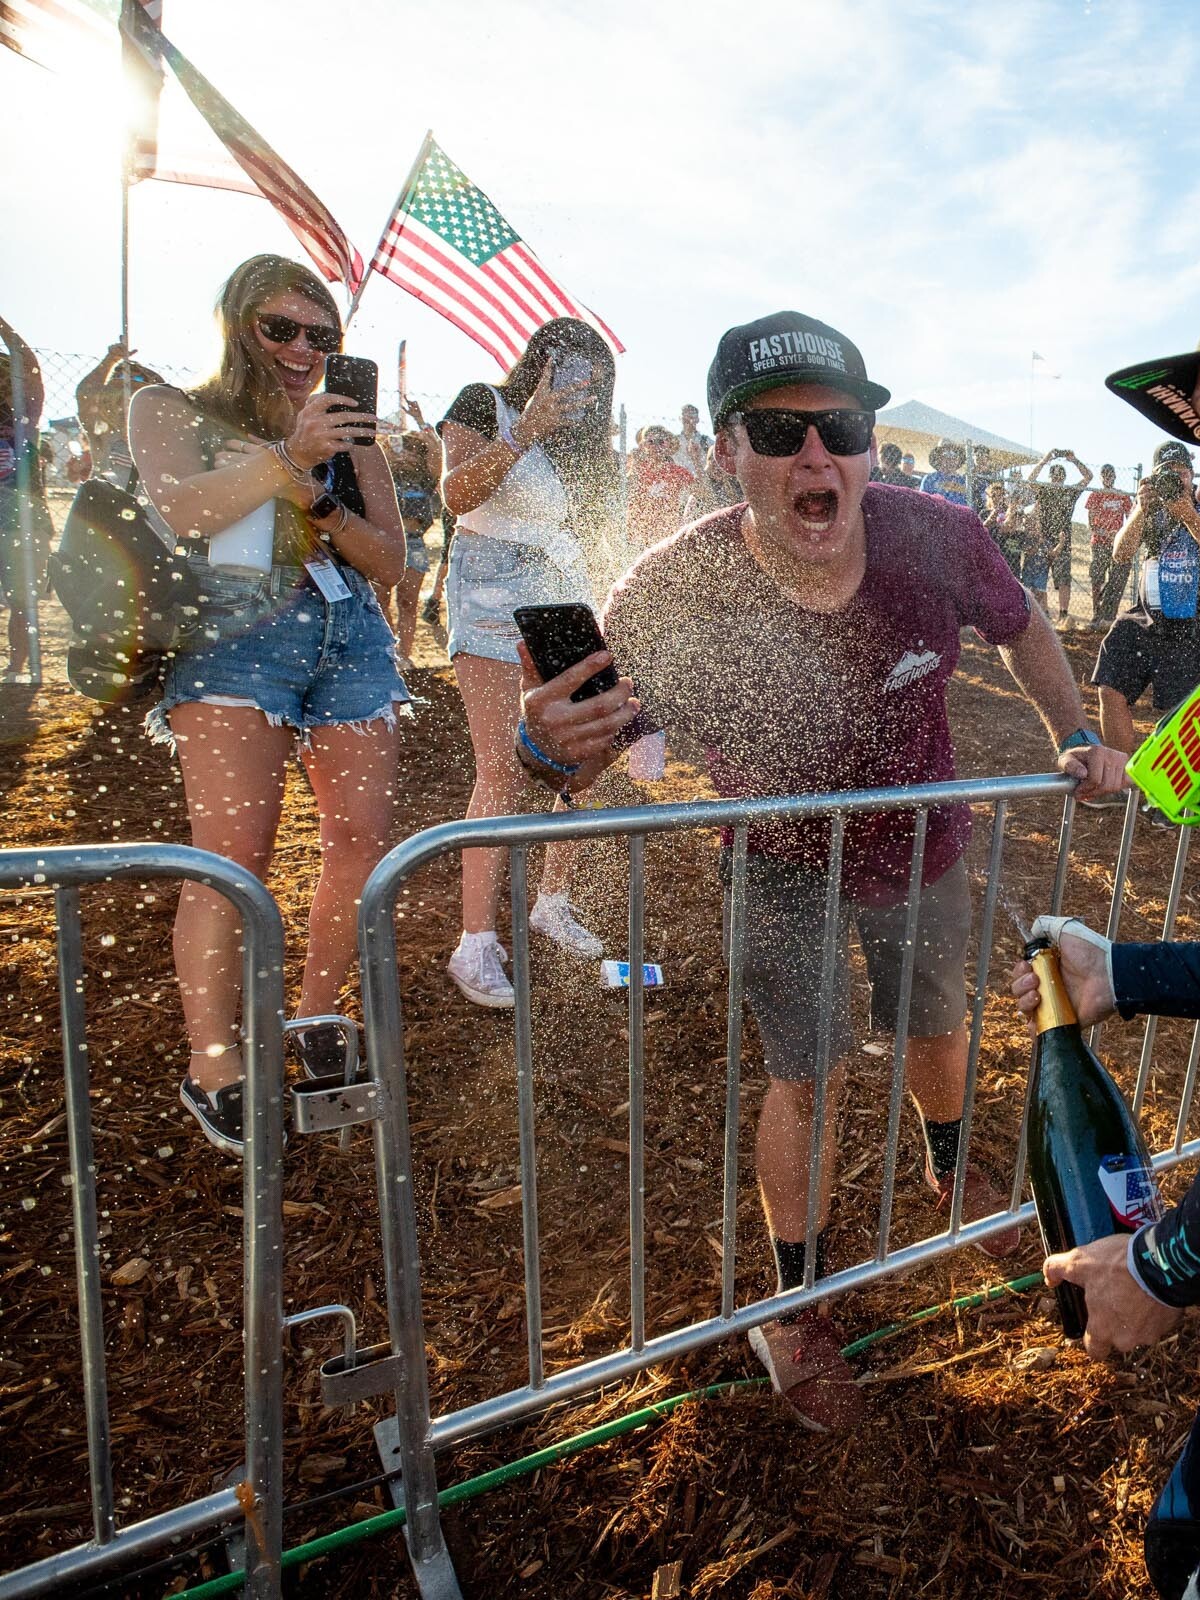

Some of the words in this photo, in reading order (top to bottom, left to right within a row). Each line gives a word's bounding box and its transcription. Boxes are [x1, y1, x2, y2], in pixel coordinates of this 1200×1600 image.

[749, 331, 845, 362] FASTHOUSE
[753, 357, 778, 373] SPEED.
[779, 353, 806, 366] STYLE.
[807, 354, 826, 366] GOOD
[1146, 384, 1200, 433] YAMAHA
[883, 654, 943, 693] FASTHOUSE
